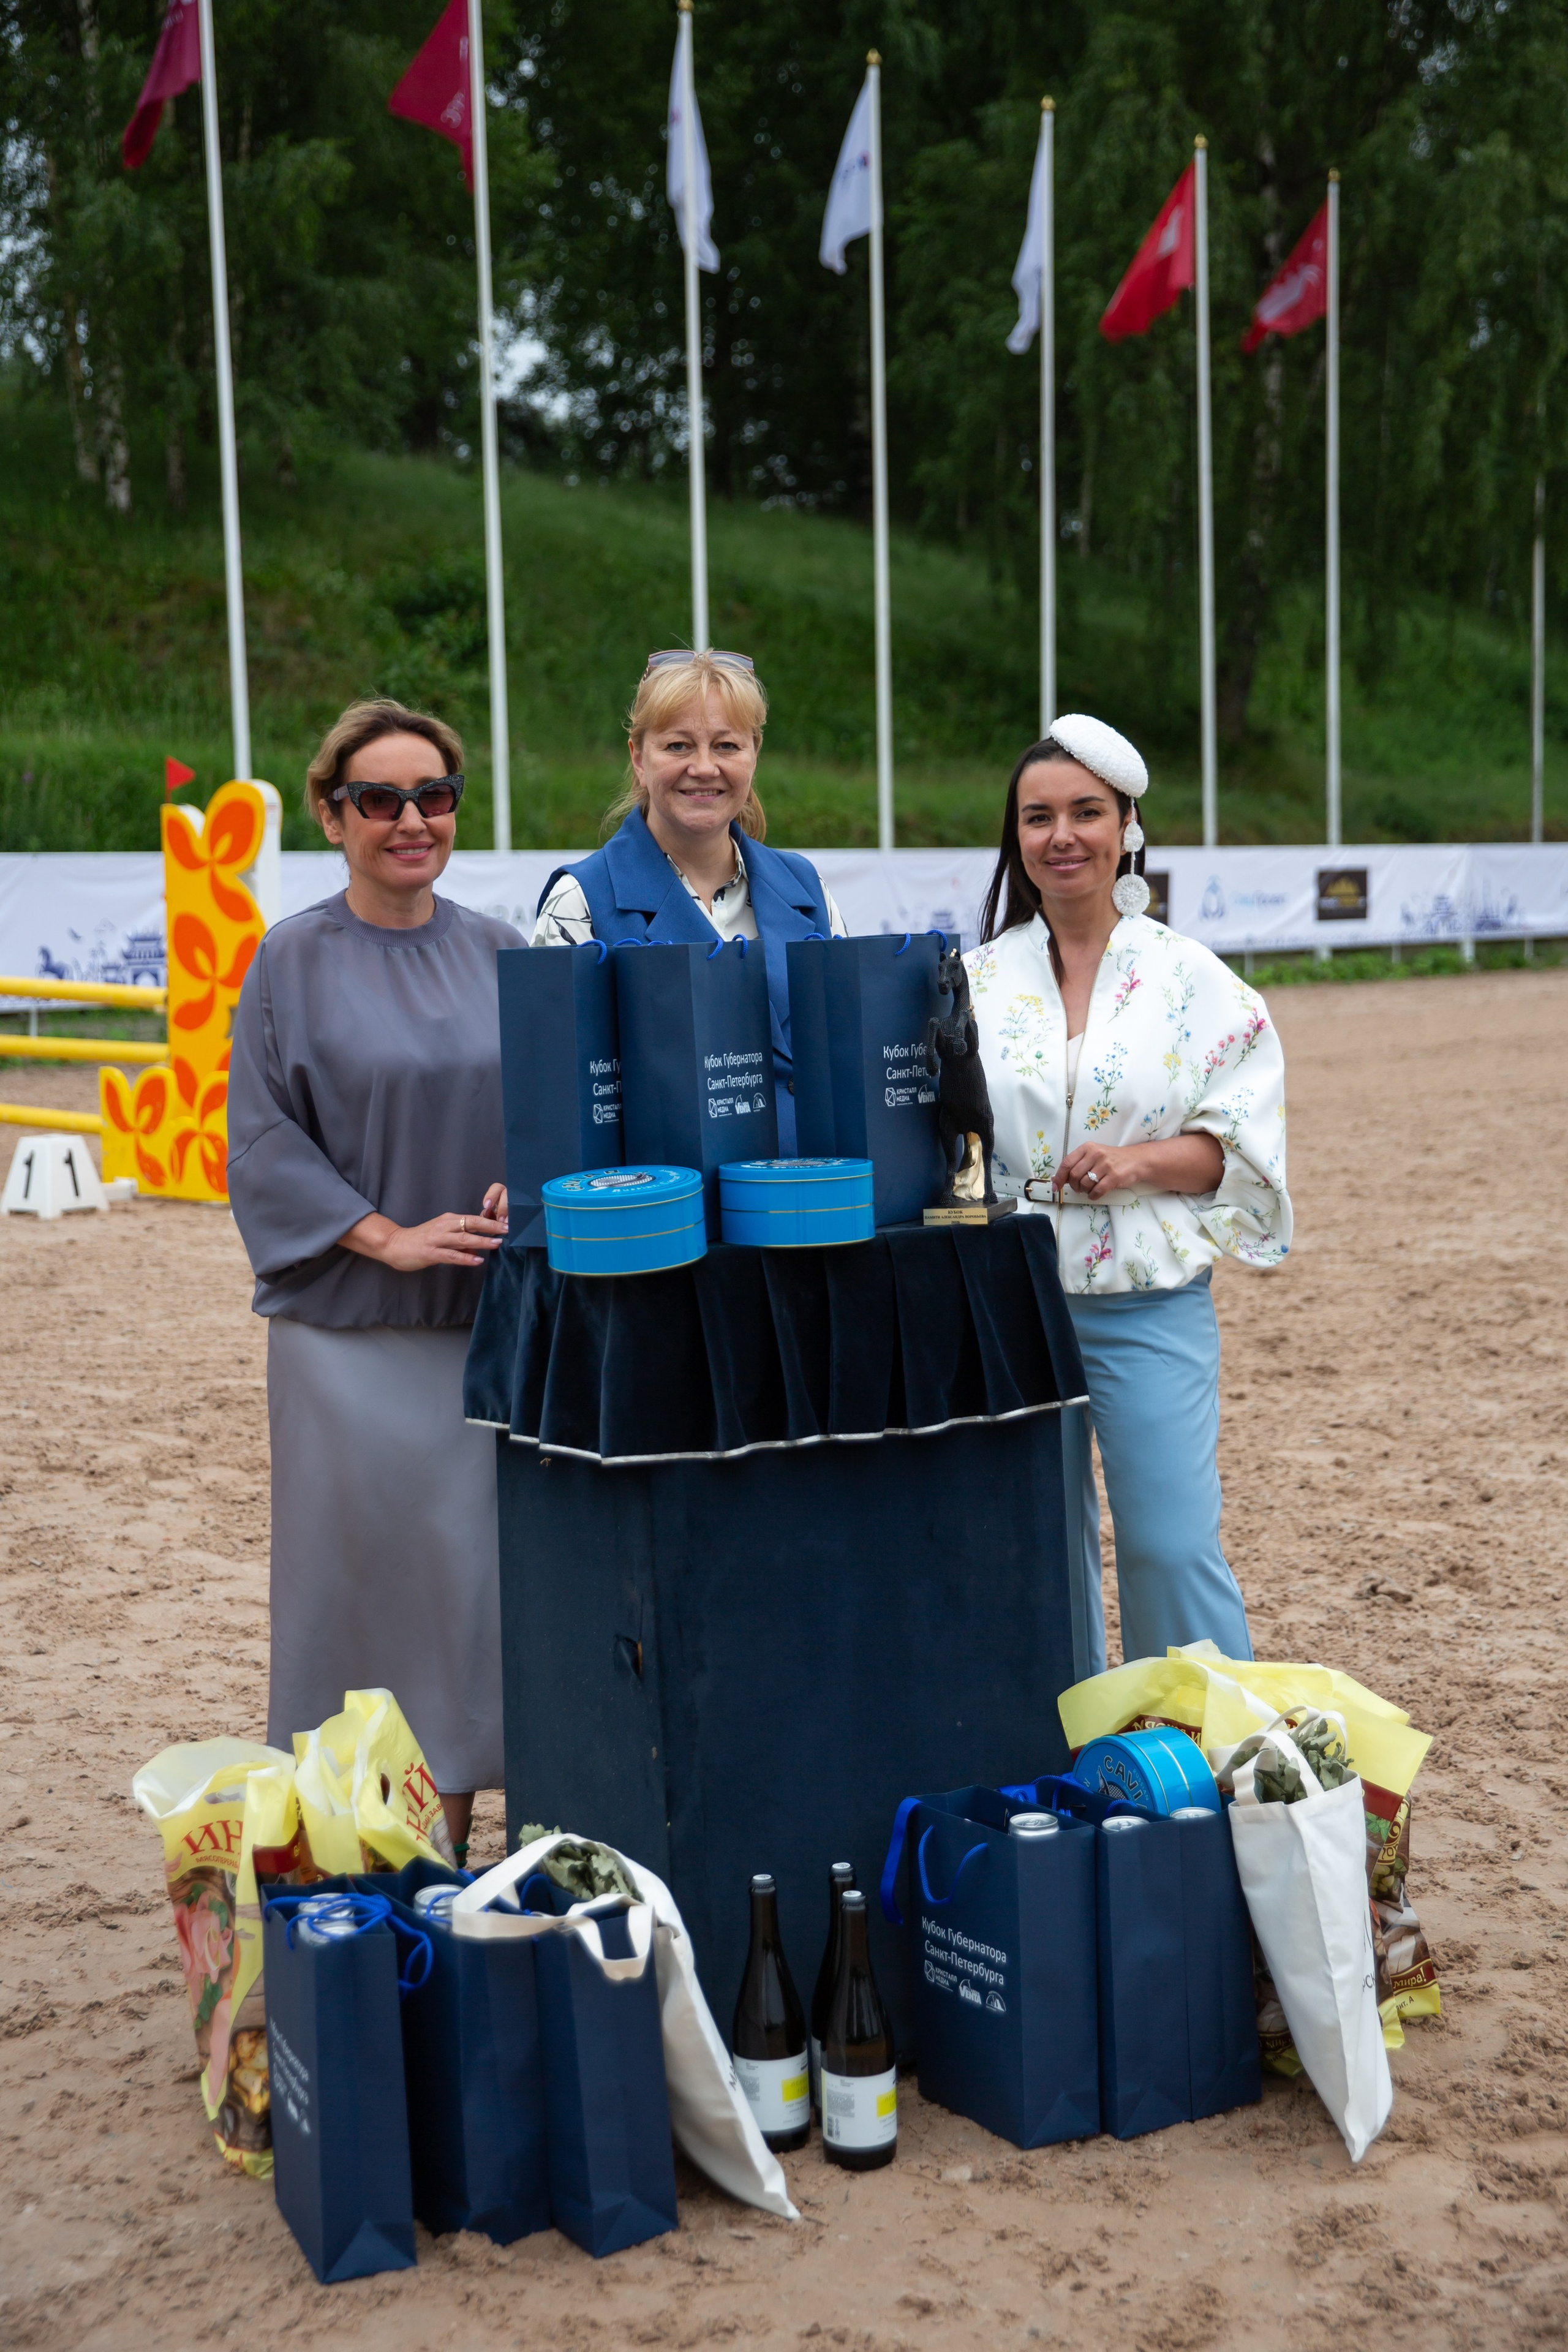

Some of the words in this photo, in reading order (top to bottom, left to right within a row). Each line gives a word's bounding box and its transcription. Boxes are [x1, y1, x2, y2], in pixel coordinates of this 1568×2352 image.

[704, 1055, 723, 1071] Кубок
[723, 1052, 763, 1068] Губернатора
[883, 1044, 909, 1061] Кубок
[590, 1059, 612, 1076] Кубок
[707, 1072, 763, 1090] Санкт-Петербурга
[896, 1087, 917, 1095] КРИСТАЛЛ
[23, 1149, 35, 1199] 1
[64, 1148, 80, 1197] 1
[1104, 1755, 1147, 1809] CAVI
[922, 1915, 946, 1939] Кубок
[948, 1928, 1007, 1963] Губернатора
[925, 1939, 1005, 1985] Санкт-Петербурга
[935, 1967, 958, 1983] КРИСТАЛЛ
[935, 1973, 949, 1986] МЕДИА
[1393, 1966, 1427, 1989] мира!
[959, 1985, 982, 2005] VENTA
